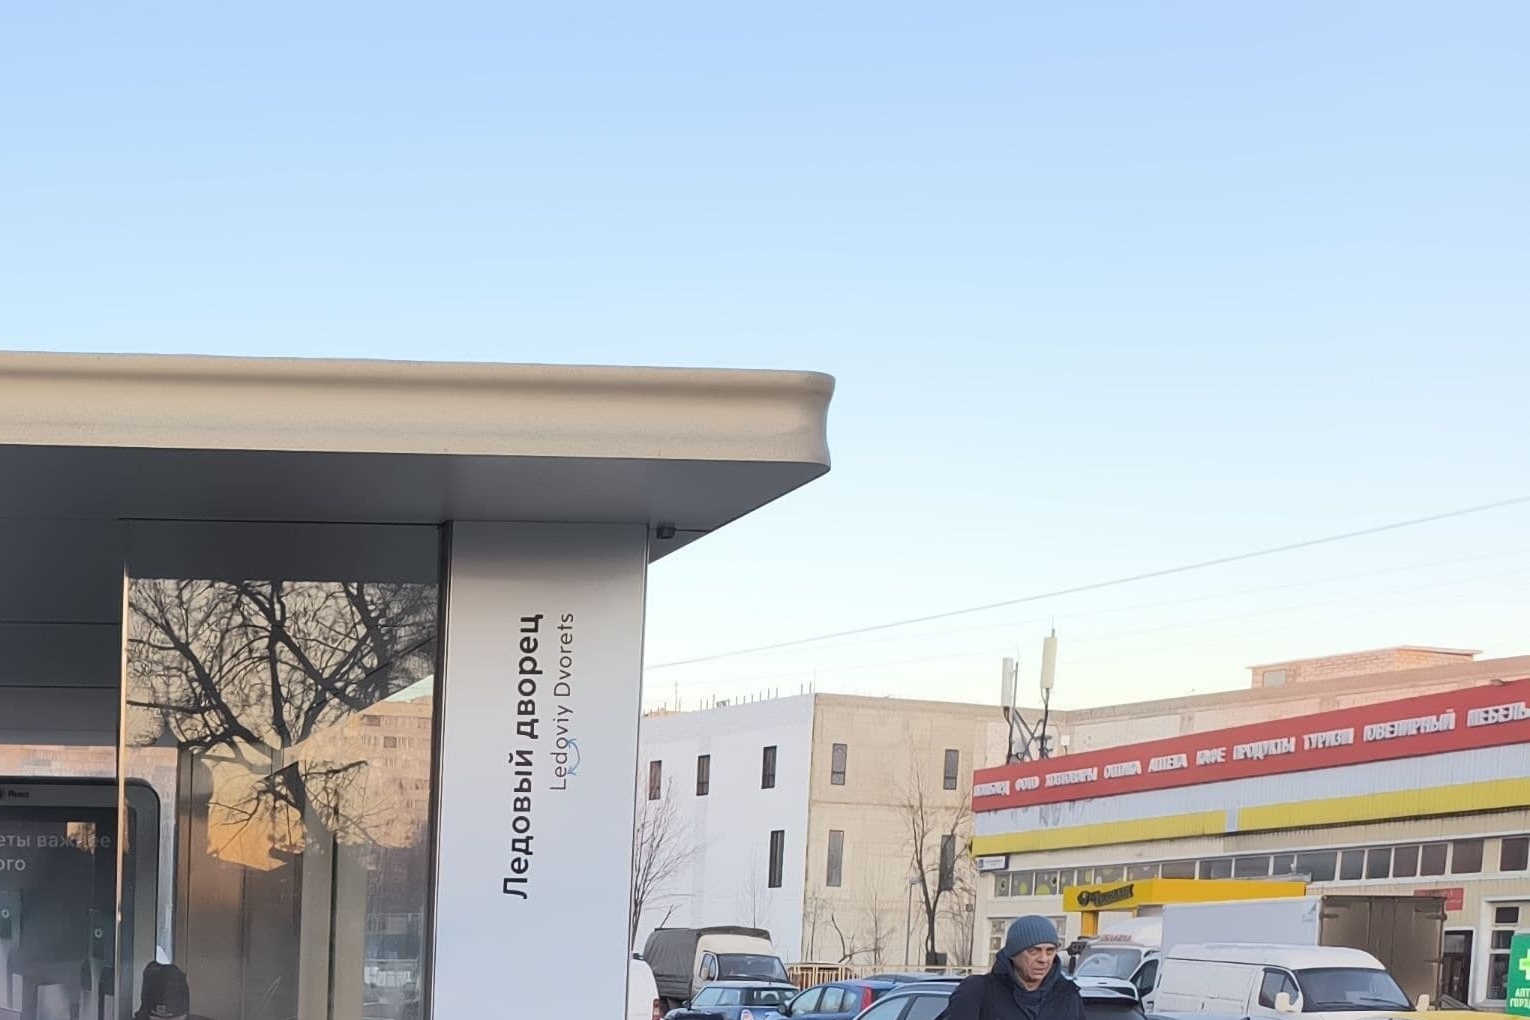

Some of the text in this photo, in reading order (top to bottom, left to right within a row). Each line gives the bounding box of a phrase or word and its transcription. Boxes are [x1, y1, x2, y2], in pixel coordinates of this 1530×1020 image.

[503, 614, 543, 899] Ледовый дворец
[550, 613, 574, 790] Ledoviy Dvorets
[1148, 753, 1188, 773] АПТЕКА
[1196, 747, 1227, 765] КАФЕ
[1233, 736, 1296, 760] ПРОДУКТЫ
[1302, 727, 1355, 750] ТУРИЗМ
[1363, 708, 1456, 742] ЮВЕЛИРНЫЙ
[1467, 701, 1530, 728] МЕБЕЛЬ
[37, 834, 111, 849] важе
